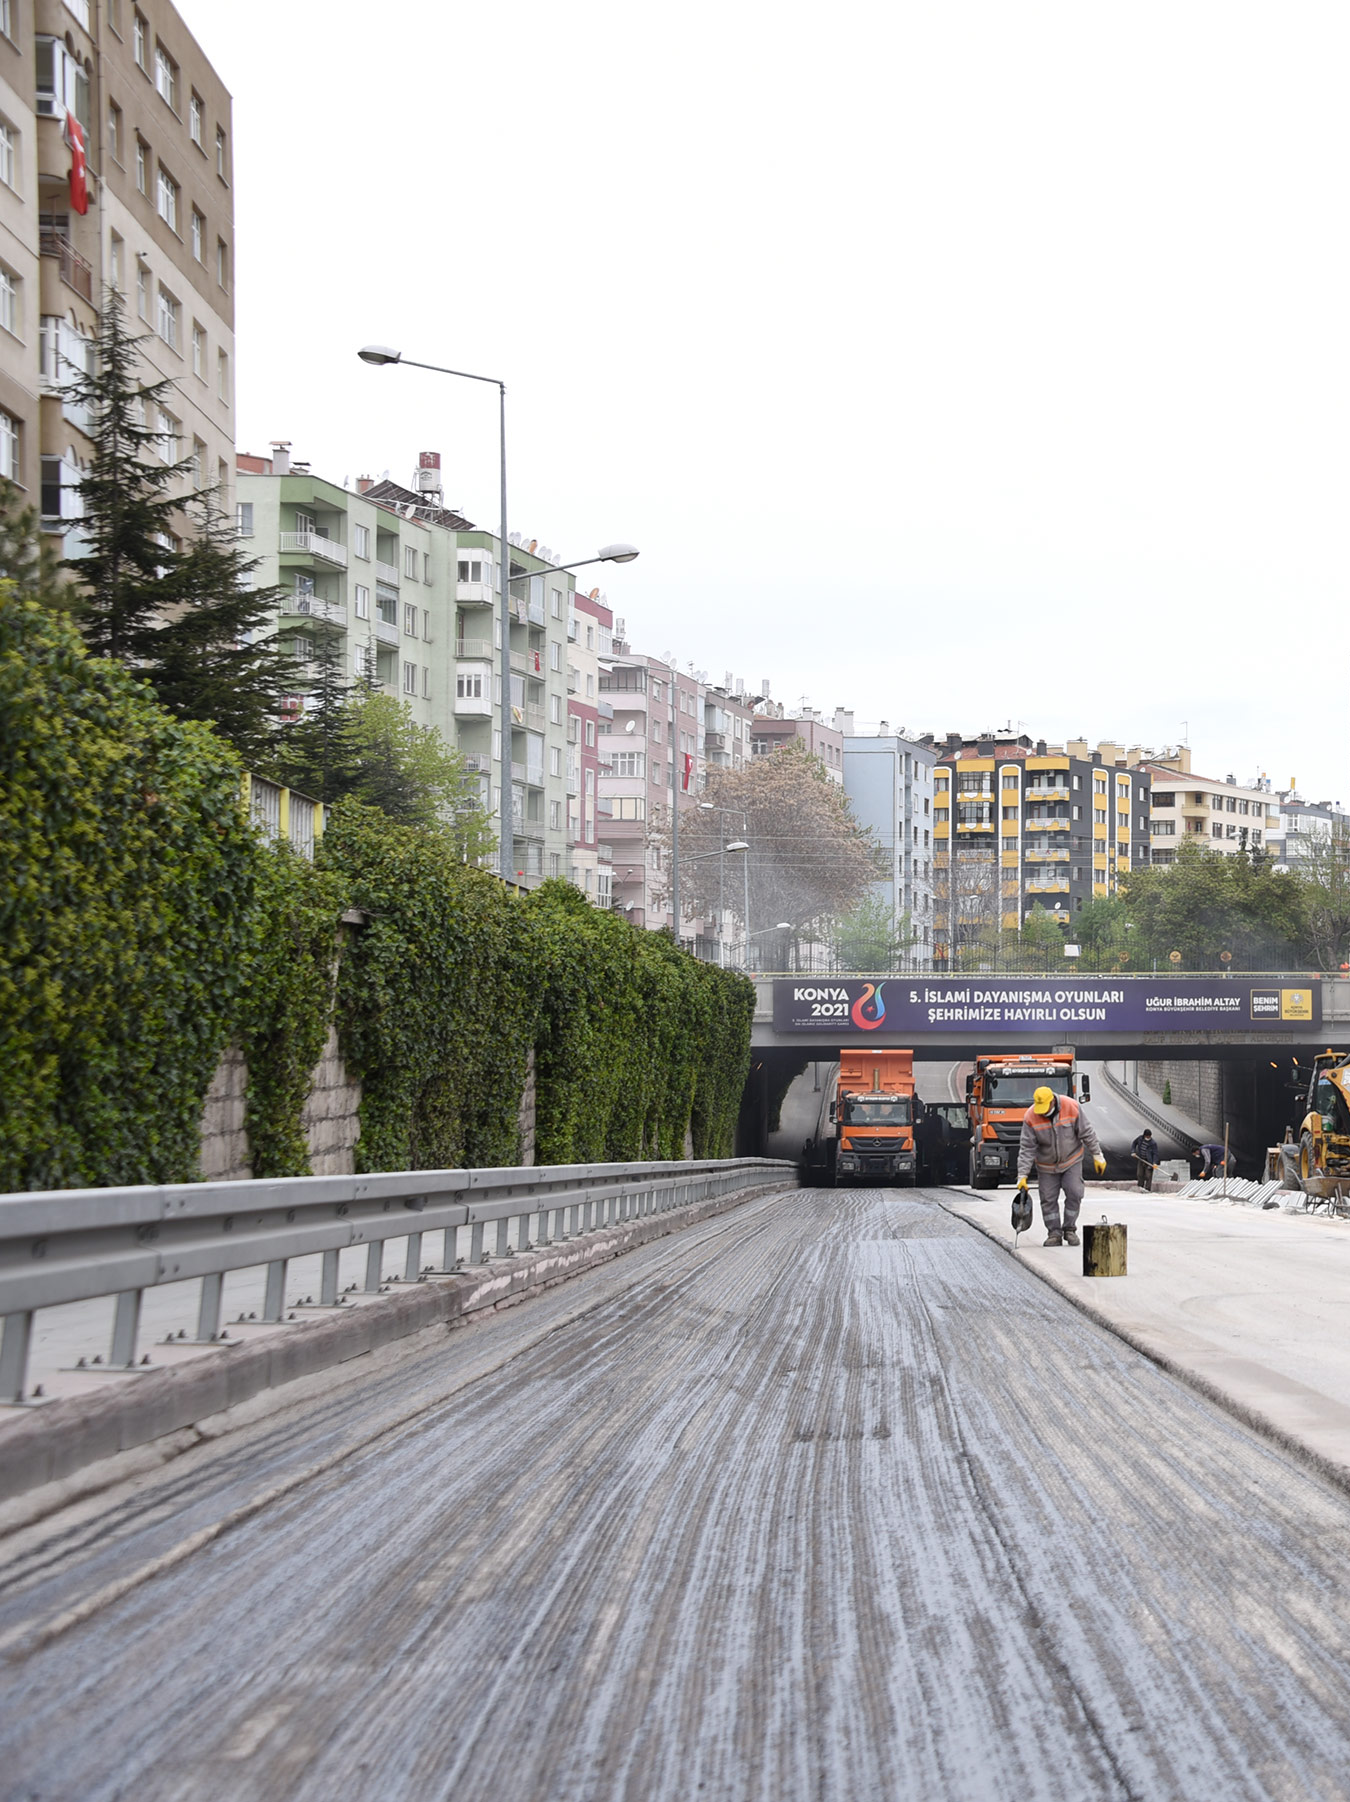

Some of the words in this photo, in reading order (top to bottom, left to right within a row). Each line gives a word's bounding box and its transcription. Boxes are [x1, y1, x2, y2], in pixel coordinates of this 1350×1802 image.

[794, 988, 849, 1001] KONYA
[909, 991, 921, 1003] 5.
[925, 988, 970, 1003] İSLAMİ
[974, 991, 1052, 1006] DAYANIŞMA
[1054, 990, 1124, 1003] OYUNLARI
[1146, 997, 1172, 1007] UĞUR
[1174, 996, 1212, 1006] İBRAHİM
[1213, 998, 1241, 1006] ALTAY
[811, 1003, 849, 1016] 2021
[928, 1006, 1001, 1023] ŞEHRİMİZE
[1004, 1008, 1057, 1020] HAYIRLI
[1059, 1008, 1106, 1020] OLSUN
